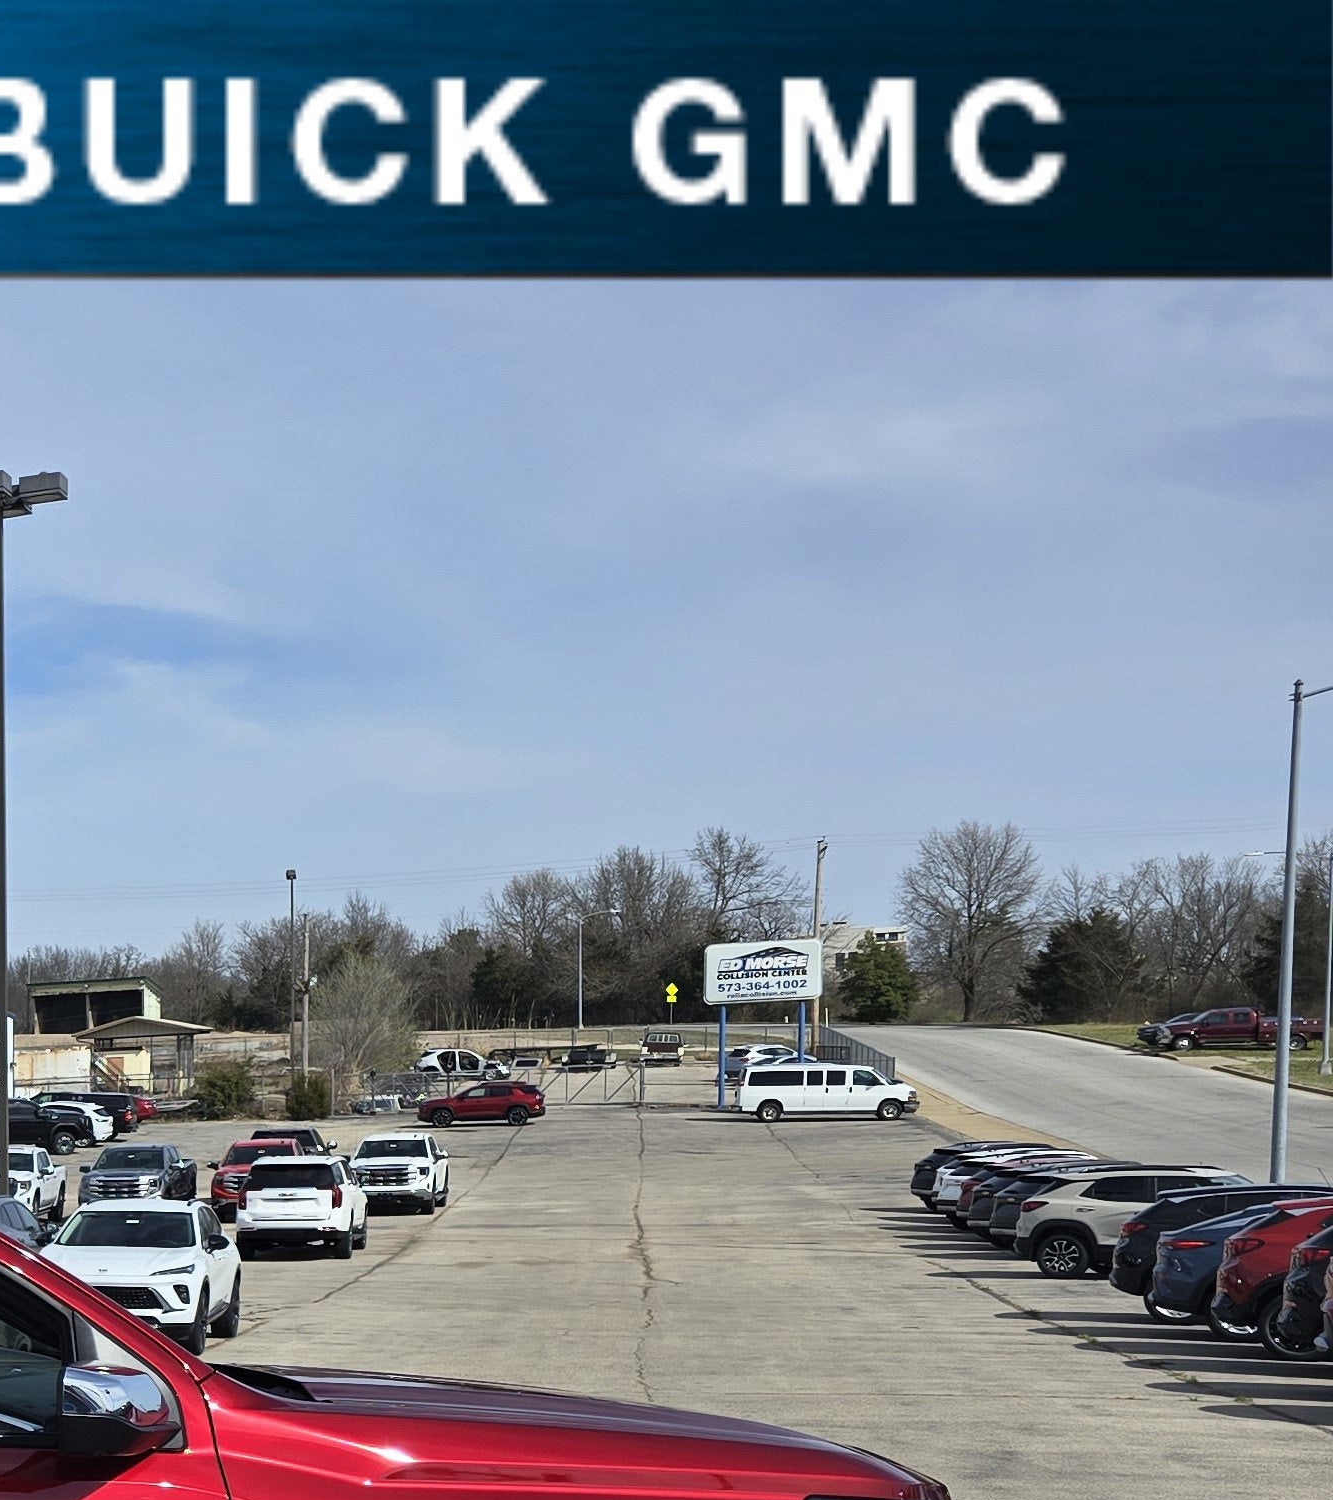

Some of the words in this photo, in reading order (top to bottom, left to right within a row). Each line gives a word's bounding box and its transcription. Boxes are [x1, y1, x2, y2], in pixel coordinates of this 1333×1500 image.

[719, 958, 743, 971] ED
[744, 955, 809, 970] MORSE
[717, 971, 768, 980] COLLISION
[771, 969, 808, 977] CENTER
[718, 979, 808, 992] 573-364-1002
